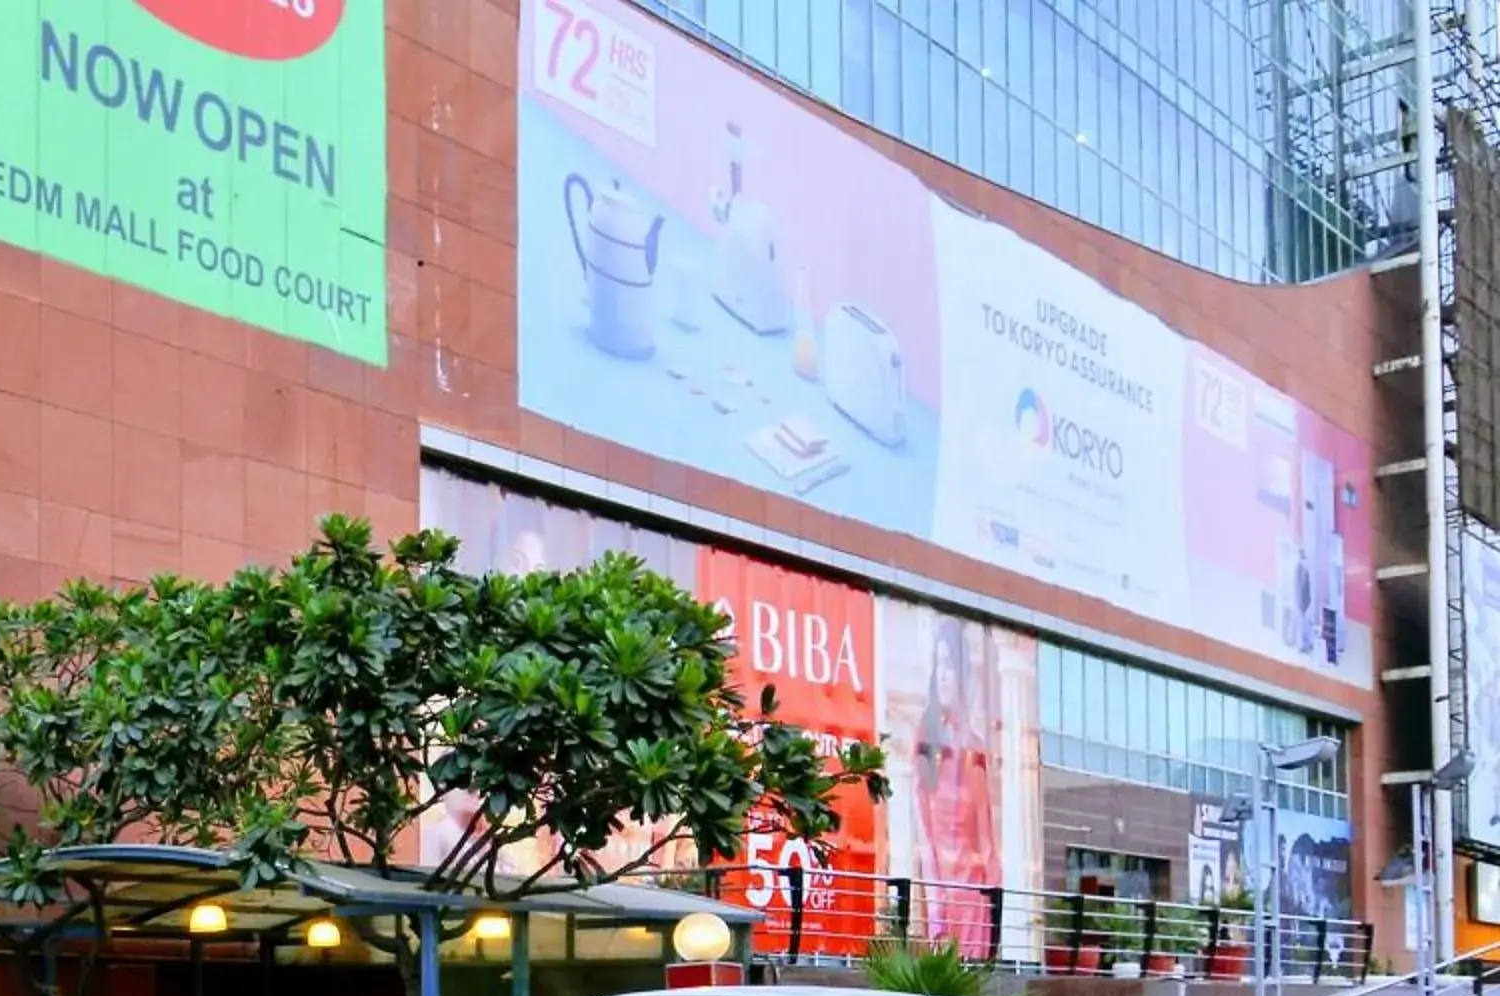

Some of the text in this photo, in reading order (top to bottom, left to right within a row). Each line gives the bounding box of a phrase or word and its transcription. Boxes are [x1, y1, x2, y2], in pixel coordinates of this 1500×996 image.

[544, 0, 647, 101] 72 HRS
[41, 20, 336, 197] NOW OPEN
[177, 174, 214, 220] at
[76, 190, 167, 256] MALL
[177, 230, 264, 287] FOOD
[275, 266, 371, 324] COURT
[981, 303, 1153, 414] TO KORYO ASSURANCE
[1037, 298, 1107, 357] UPGRADE
[1053, 413, 1123, 480] KORYO
[753, 601, 863, 693] BIBA
[810, 889, 835, 909] OFF
